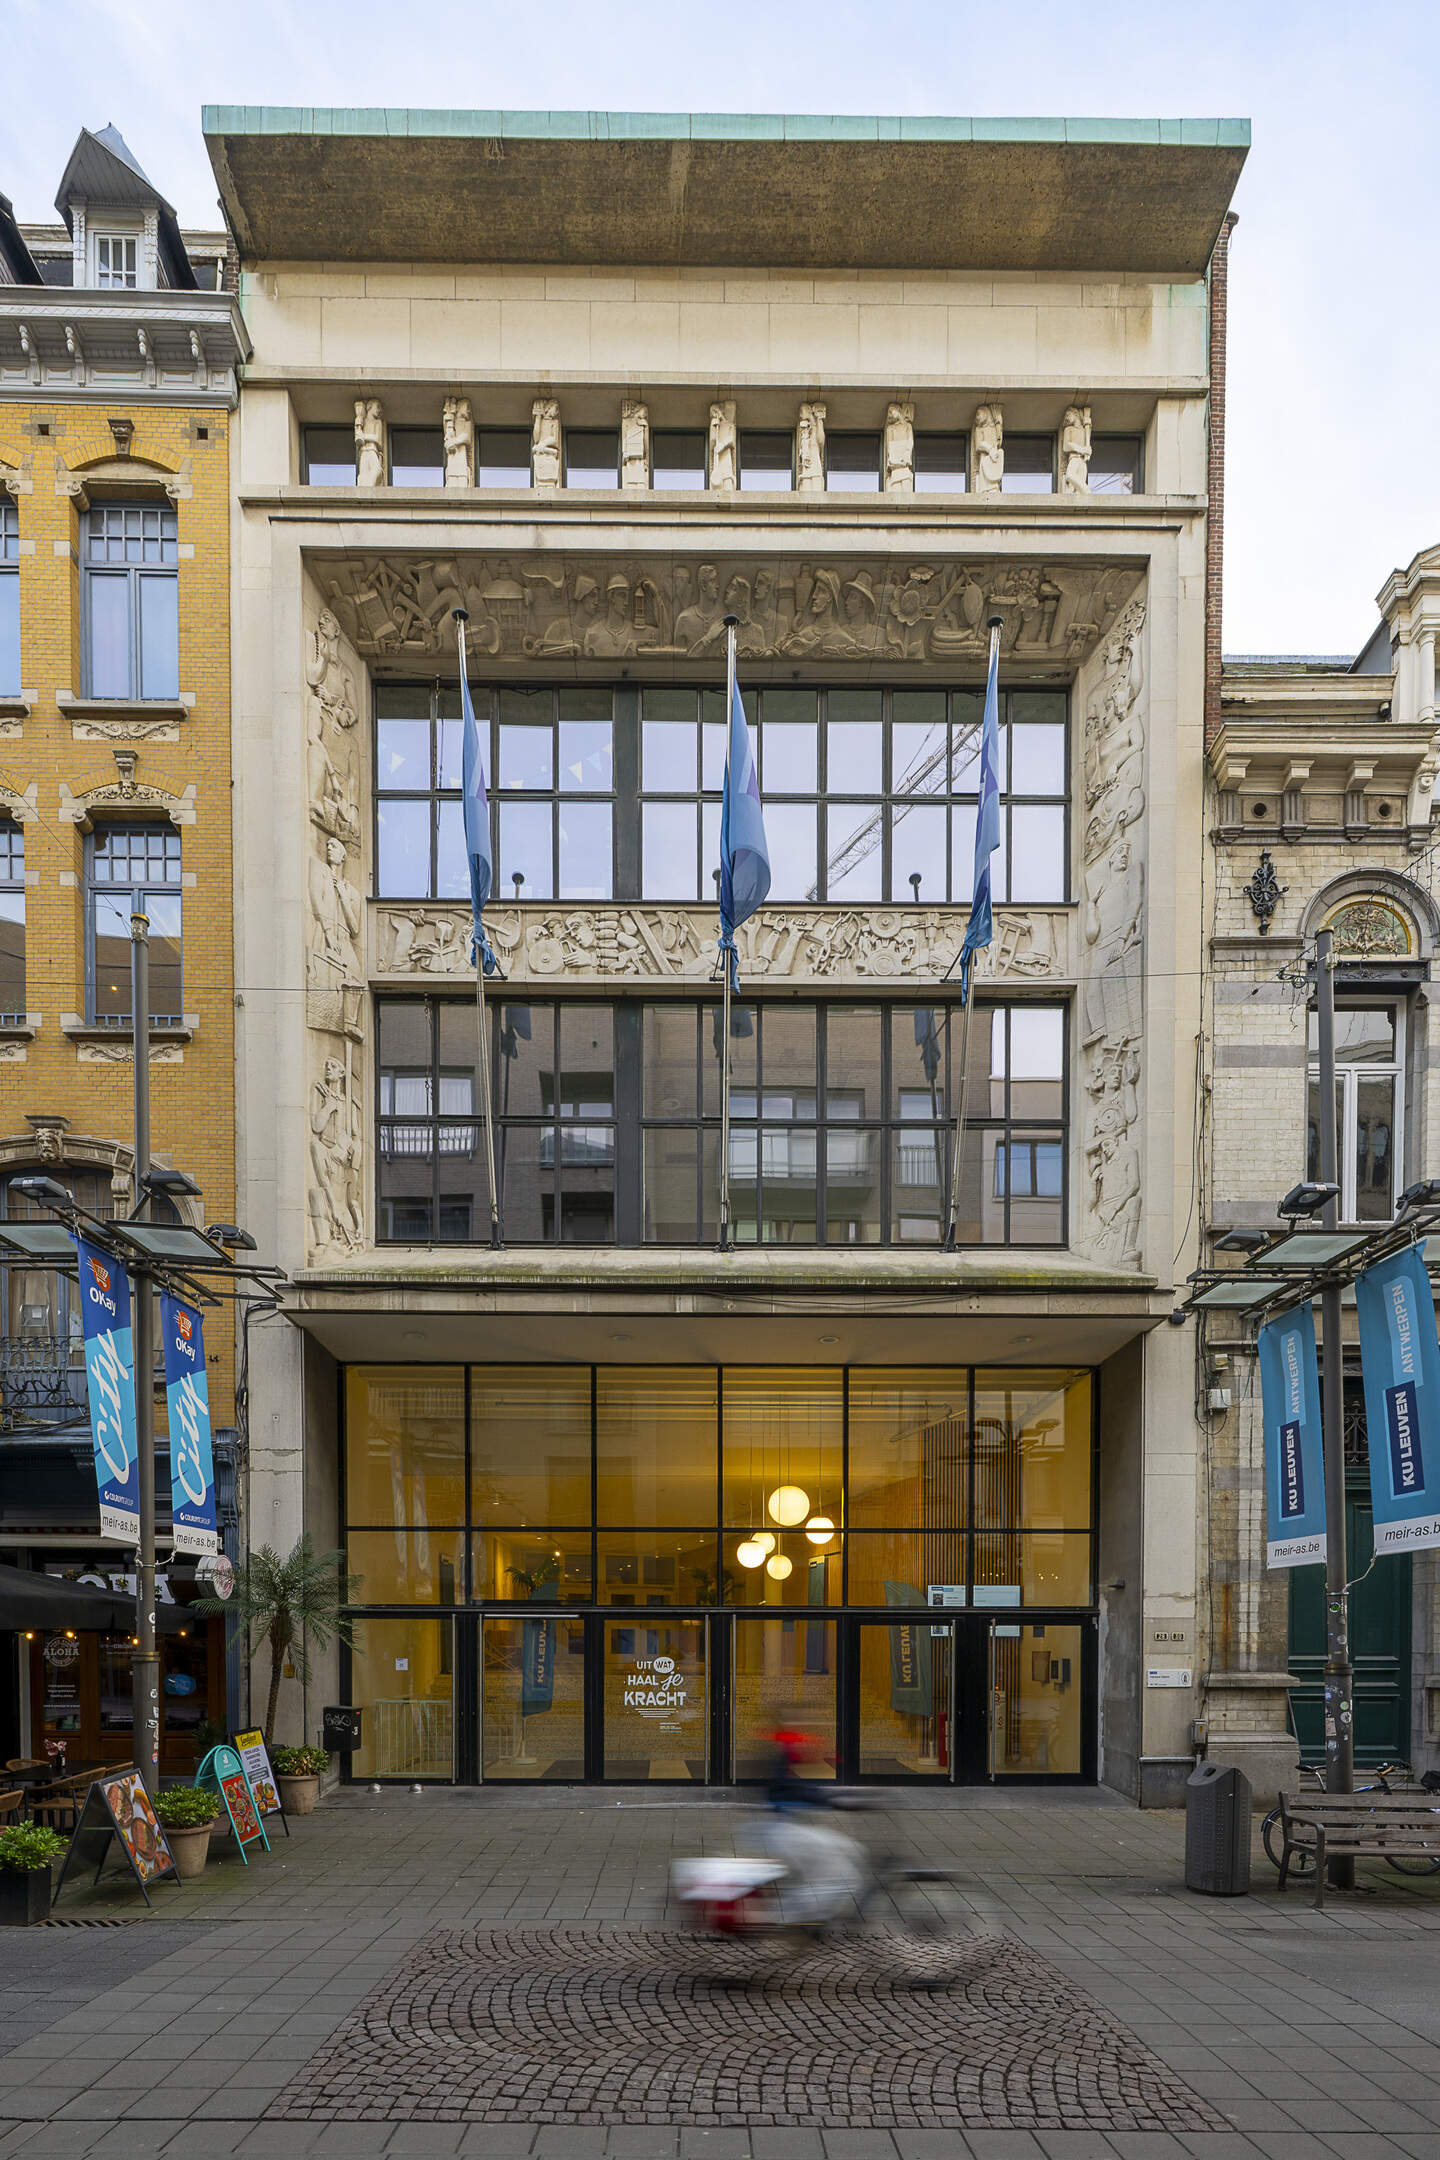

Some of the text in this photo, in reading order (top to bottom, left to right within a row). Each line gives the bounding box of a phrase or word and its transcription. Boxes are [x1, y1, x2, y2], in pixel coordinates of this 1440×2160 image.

[89, 1286, 117, 1317] OKay
[1392, 1284, 1414, 1373] ANTWERPEN
[175, 1337, 196, 1362] OKay
[1288, 1336, 1300, 1414] ANTWERPEN
[91, 1328, 130, 1485] City
[175, 1372, 208, 1506] City
[1395, 1390, 1415, 1487] KU LEUVEN
[1286, 1428, 1297, 1511] KU LEUVEN
[102, 1515, 138, 1534] meir-as.be
[1384, 1521, 1440, 1541] meir-as.b
[176, 1533, 216, 1548] meir-as.be
[1274, 1542, 1320, 1557] meir-as.be
[43, 1648, 80, 1656] ALOHA
[537, 1619, 547, 1683] KU LEUV
[636, 1661, 672, 1670] UIT WAT
[627, 1671, 684, 1691] HAAL je
[624, 1691, 687, 1706] KRACHT
